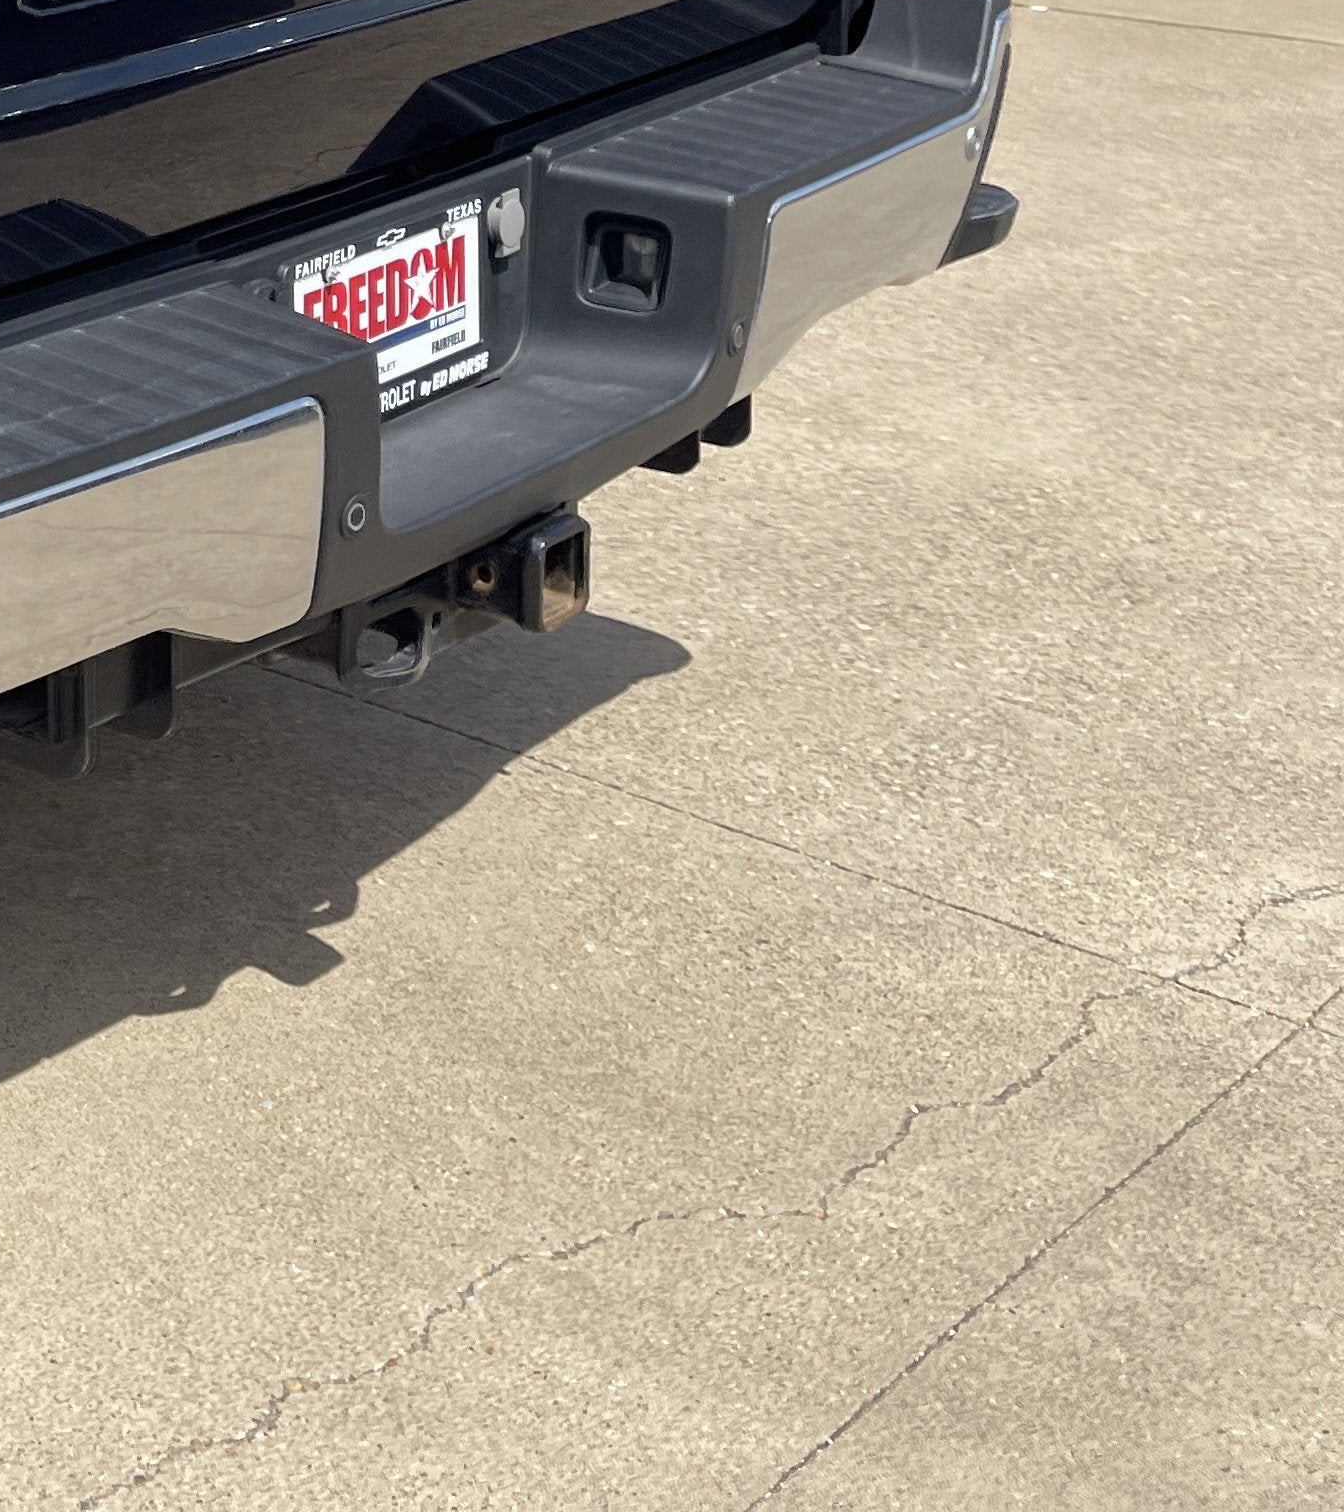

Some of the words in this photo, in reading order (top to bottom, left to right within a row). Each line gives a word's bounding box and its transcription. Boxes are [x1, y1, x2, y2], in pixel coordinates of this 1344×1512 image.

[446, 198, 482, 223] TEXAS
[294, 244, 356, 280] FAIRFIELD
[303, 234, 466, 342] FREEDOM
[379, 379, 417, 413] ROLET
[432, 369, 449, 391] ED
[448, 351, 490, 384] MORSE
